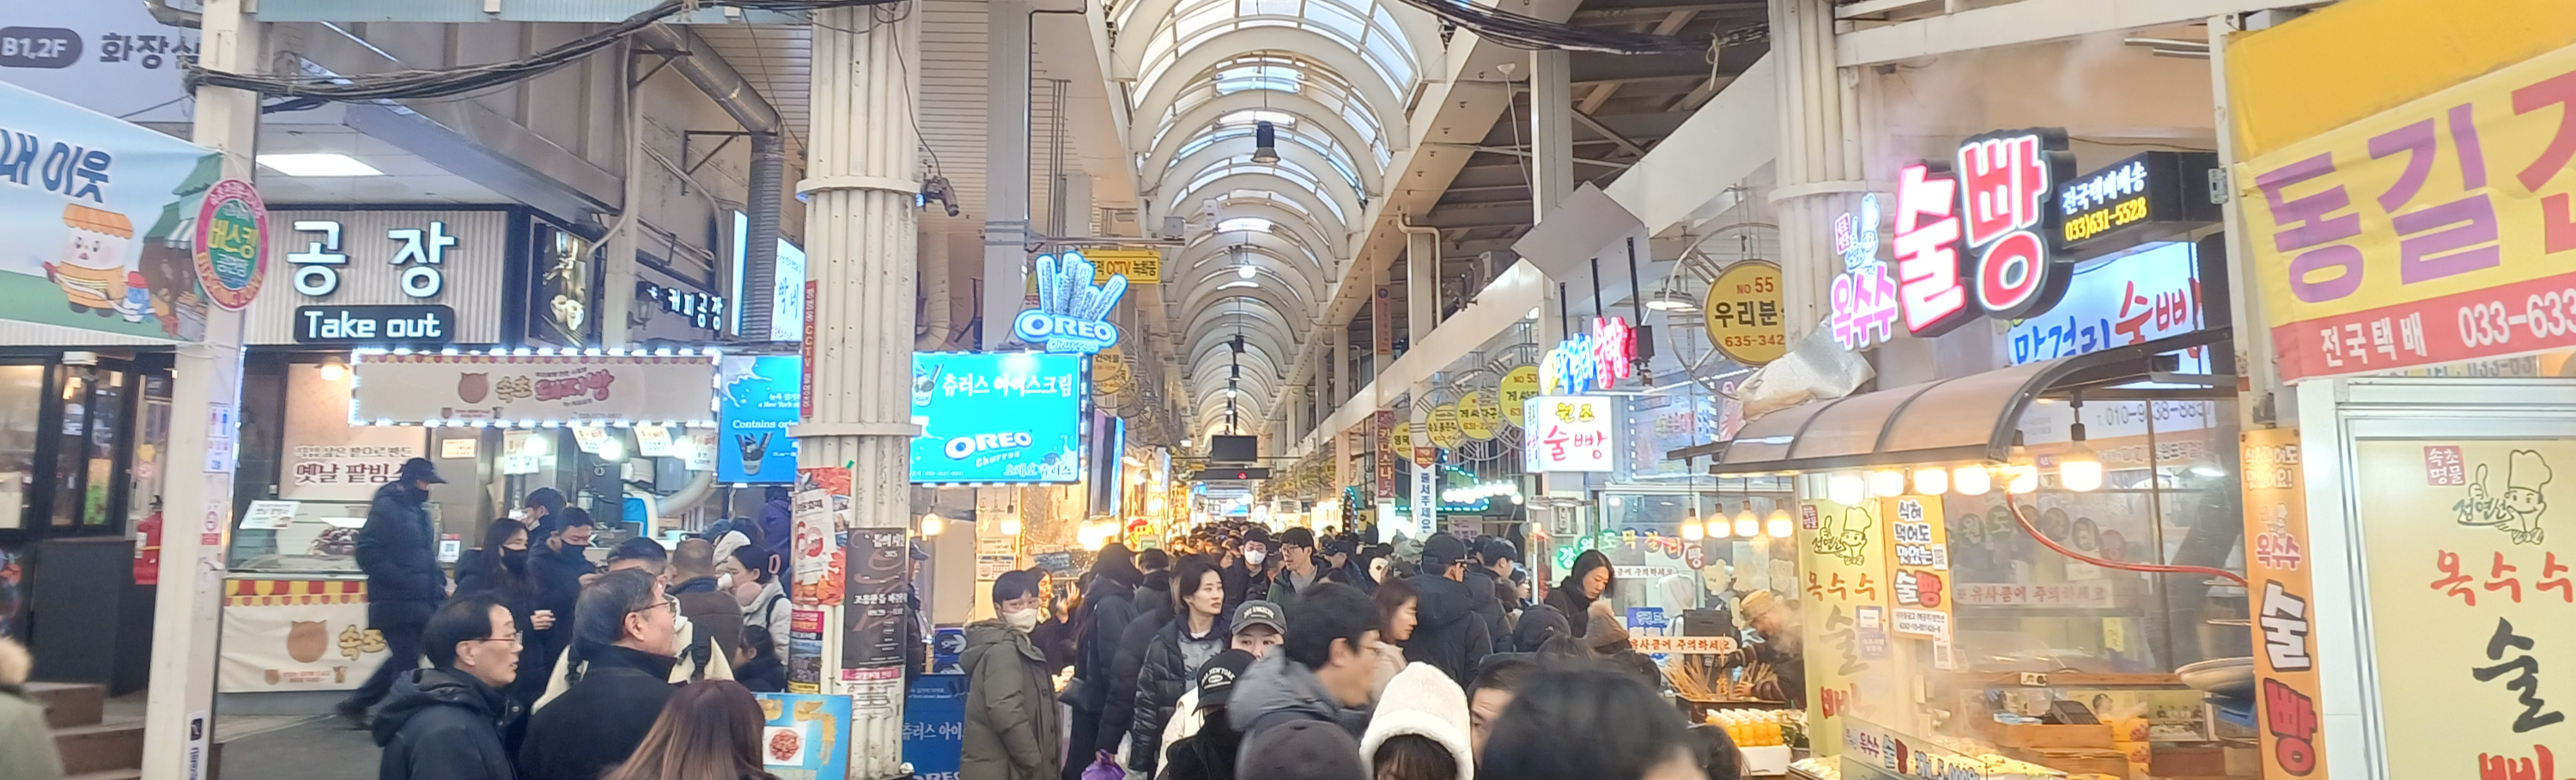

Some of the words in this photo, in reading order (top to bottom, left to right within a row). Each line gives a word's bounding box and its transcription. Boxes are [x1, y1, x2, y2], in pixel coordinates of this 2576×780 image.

[2, 37, 68, 58] B1,2F
[42, 142, 112, 204] 이웃
[2062, 161, 2148, 215] 전국택배배송
[1894, 134, 2049, 333] 술빵
[2064, 198, 2148, 241] 033)631-5528
[1106, 260, 1133, 276] CCTV
[1736, 284, 1751, 295] NO
[1754, 277, 1775, 294] 55
[1715, 301, 1785, 328] 우리분
[1834, 265, 1895, 347] 옥수수
[304, 311, 376, 338] Take
[386, 314, 441, 338] out
[1019, 312, 1113, 342] OREO
[803, 325, 815, 368] CCTV
[2320, 311, 2428, 368] 전국택배
[942, 374, 990, 398] 츄러스
[993, 373, 1072, 398] 아이스크림
[1526, 373, 1538, 384] 53
[732, 419, 776, 429] Contains
[1555, 402, 1595, 424] 원조
[945, 431, 1033, 460] OREO
[1544, 424, 1609, 462] 술빵
[2428, 448, 2459, 466] 속초
[296, 463, 340, 484] 옛날
[2429, 466, 2464, 484] 명물
[1894, 523, 1931, 543] 먹어도
[1895, 544, 1933, 566] 맛있는
[2256, 533, 2301, 571] 옥수수
[1806, 570, 1876, 602] 옥수수
[1894, 568, 1943, 608] 술빵
[2429, 549, 2575, 606] 옥수수
[2259, 578, 2318, 777] 술빵
[939, 721, 963, 741] 아이
